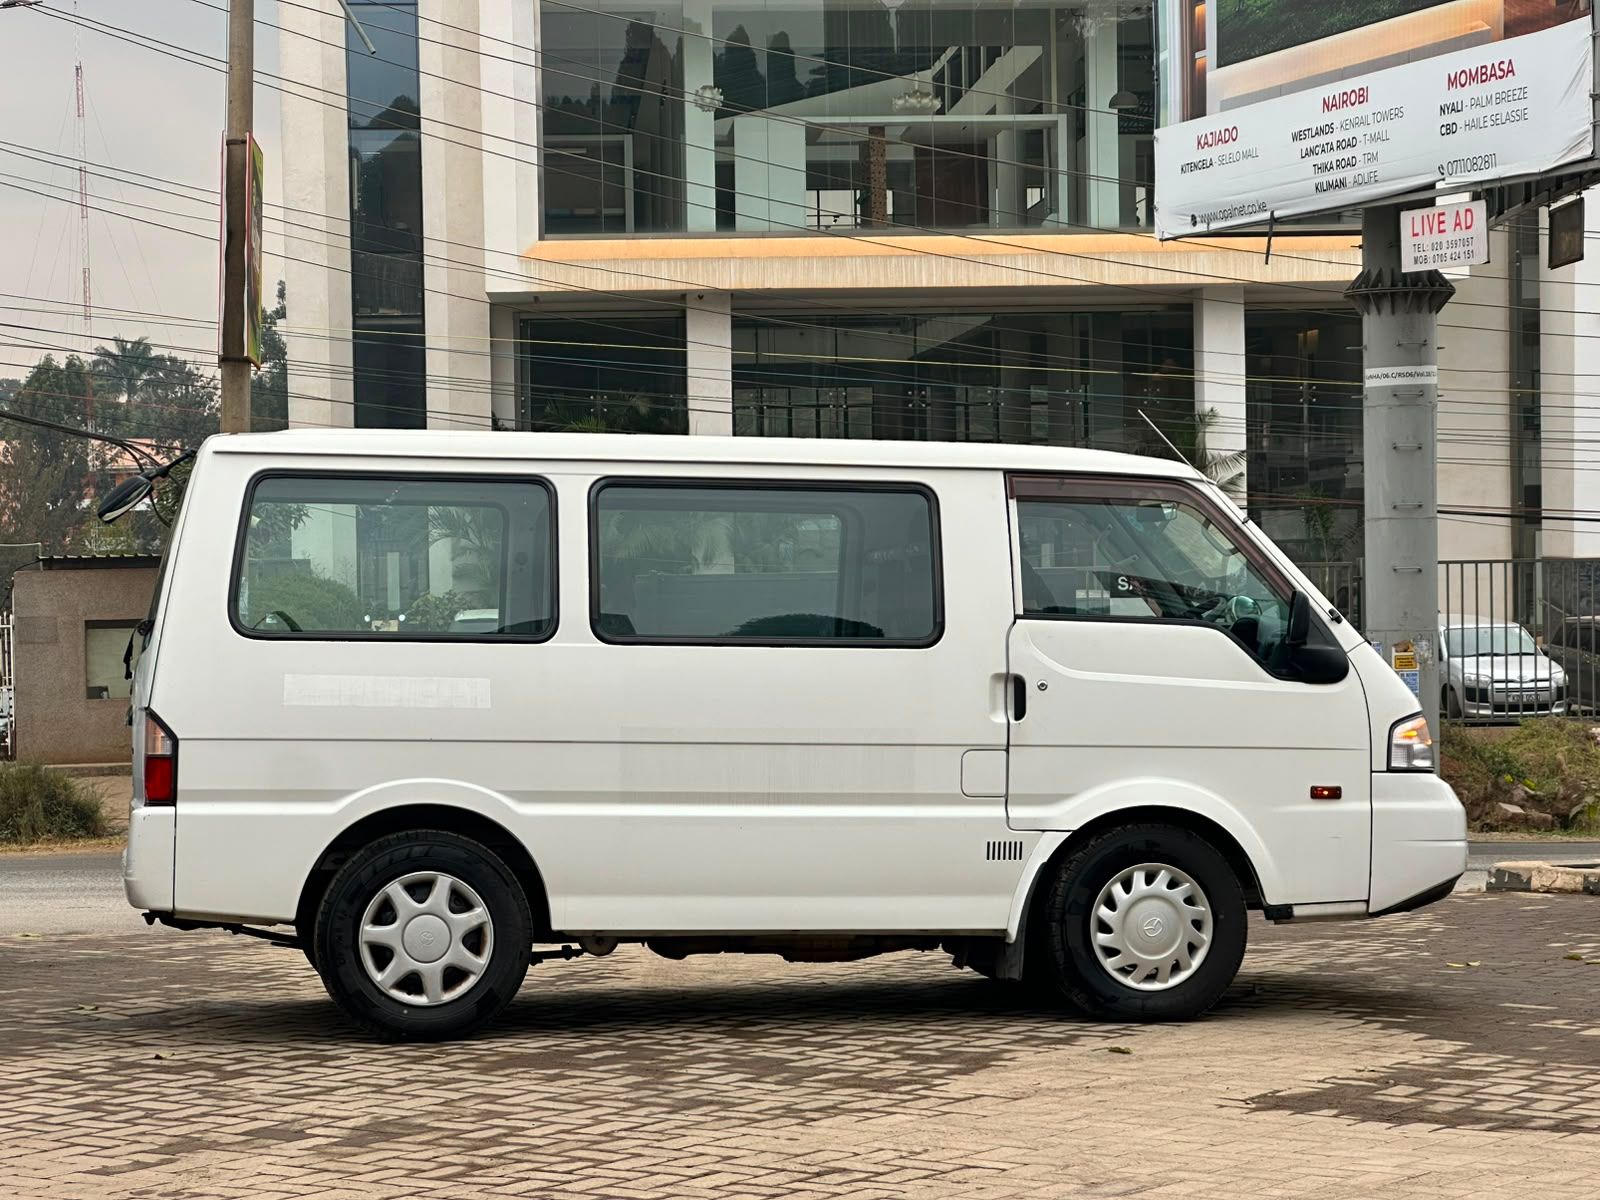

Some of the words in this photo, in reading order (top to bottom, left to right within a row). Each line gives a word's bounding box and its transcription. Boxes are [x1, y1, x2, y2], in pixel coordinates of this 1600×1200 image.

[1447, 59, 1516, 91] MOMBASA
[1322, 86, 1369, 113] NAIROBI
[1439, 100, 1464, 117] NYALI
[1470, 93, 1493, 110] PALM
[1494, 86, 1528, 105] BREEZE
[1291, 122, 1335, 143] WESTLANDS
[1340, 115, 1371, 132] KENRAIL
[1372, 106, 1405, 124] TOWERS
[1439, 122, 1458, 136] CBD
[1464, 115, 1489, 132] HAILE
[1490, 107, 1529, 127] SELASSIE
[1196, 126, 1239, 150] KAJIADO
[1300, 141, 1335, 159] LANG'ATA
[1336, 136, 1358, 152] ROAD
[1363, 129, 1390, 145] T-MALL
[1180, 157, 1214, 175] KITENGELA
[1217, 150, 1240, 167] SELELO
[1241, 147, 1259, 161] MALL
[1313, 160, 1335, 175] THIKA
[1335, 155, 1357, 170] ROAD
[1362, 151, 1379, 165] TRM
[1446, 153, 1497, 176] 0711082811
[1314, 176, 1347, 194] KILIMANI
[1352, 170, 1379, 187] ADLIFE
[1198, 200, 1268, 224] www.opalnet.co.ke
[1412, 211, 1446, 237] LIVE
[1453, 207, 1474, 232] AD
[1412, 243, 1429, 253] TEL:
[1431, 241, 1444, 252] 020
[1413, 254, 1431, 265] MOB:
[1432, 252, 1447, 264] 0705
[1449, 250, 1461, 261] 424
[1463, 249, 1474, 260] 151
